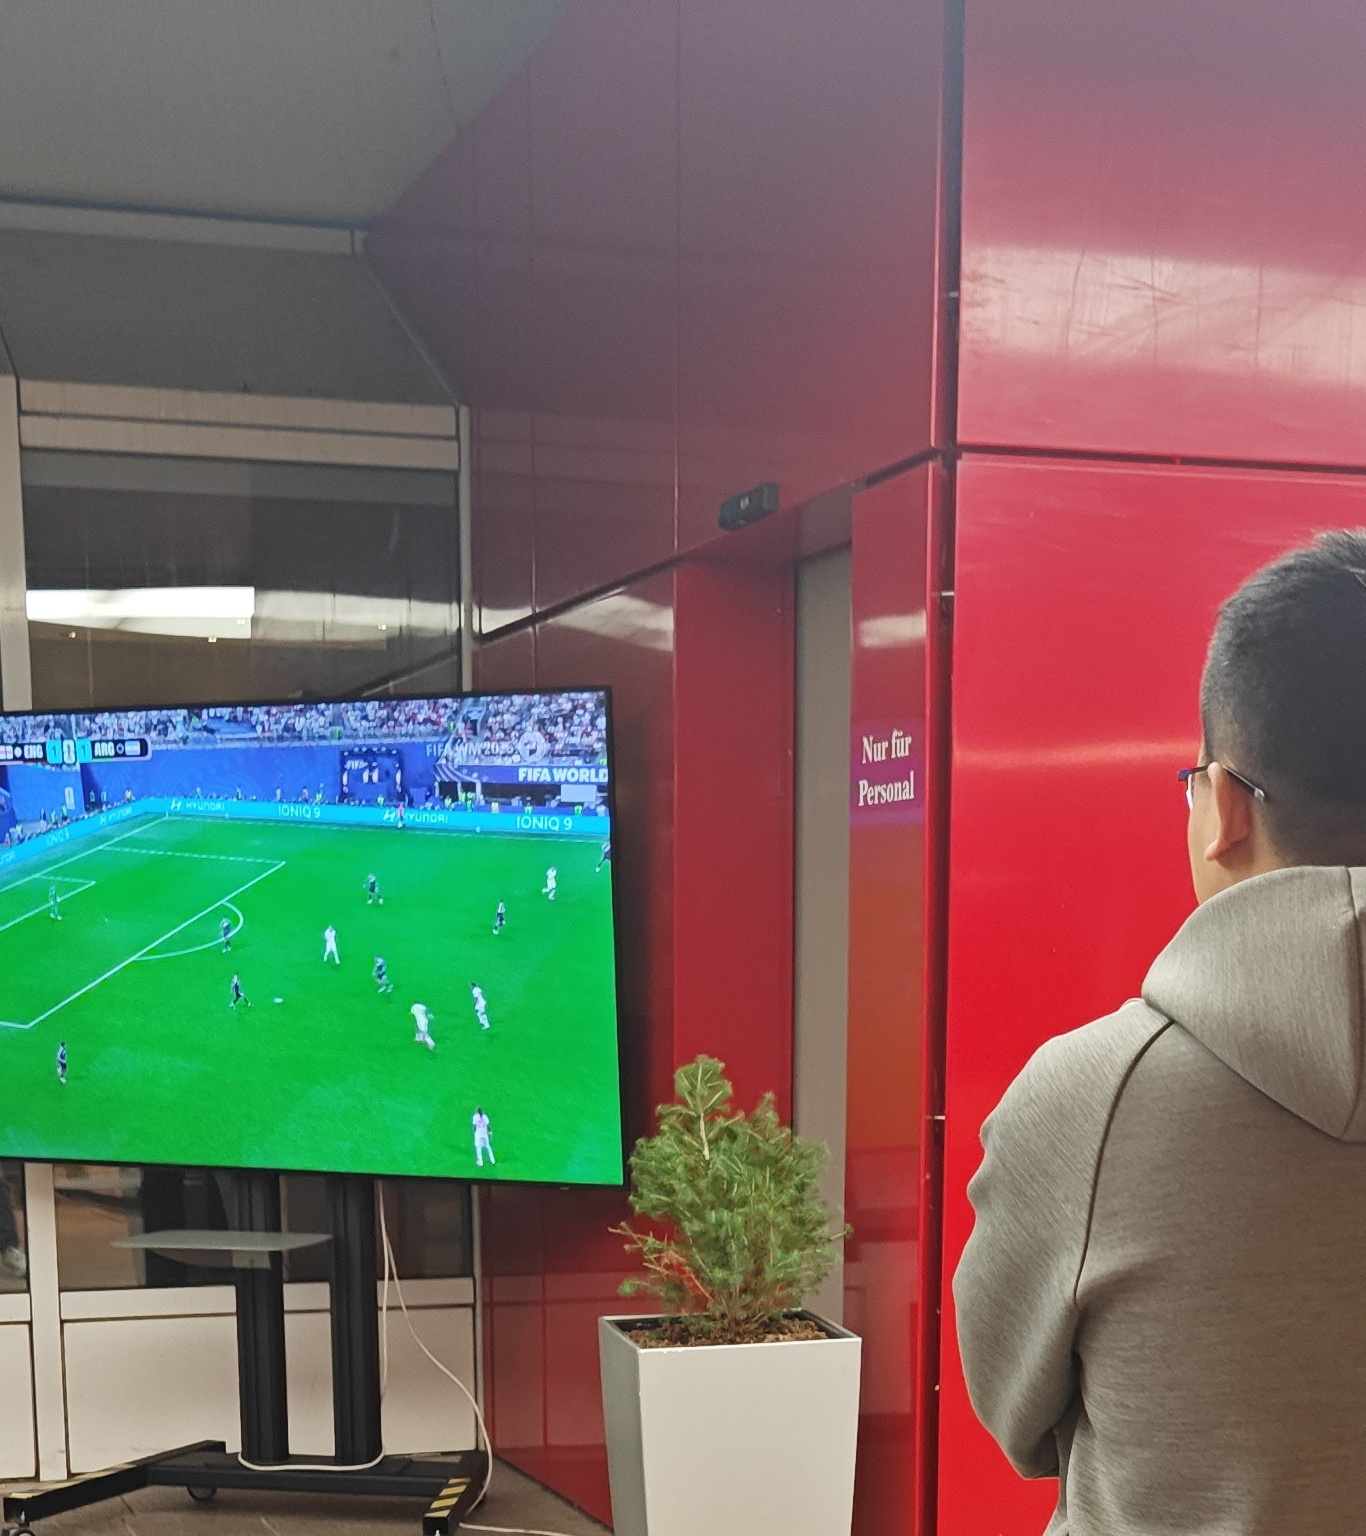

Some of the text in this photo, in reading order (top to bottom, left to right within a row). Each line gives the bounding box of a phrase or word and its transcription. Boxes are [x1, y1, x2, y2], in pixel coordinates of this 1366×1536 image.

[24, 744, 44, 759] ENG
[94, 742, 115, 757] ARG
[862, 728, 913, 764] Nur für
[518, 767, 609, 783] FIFA WORLD
[858, 770, 915, 807] Personal
[278, 804, 321, 819] IONIQ 9
[516, 815, 573, 831] IONIQ 9
